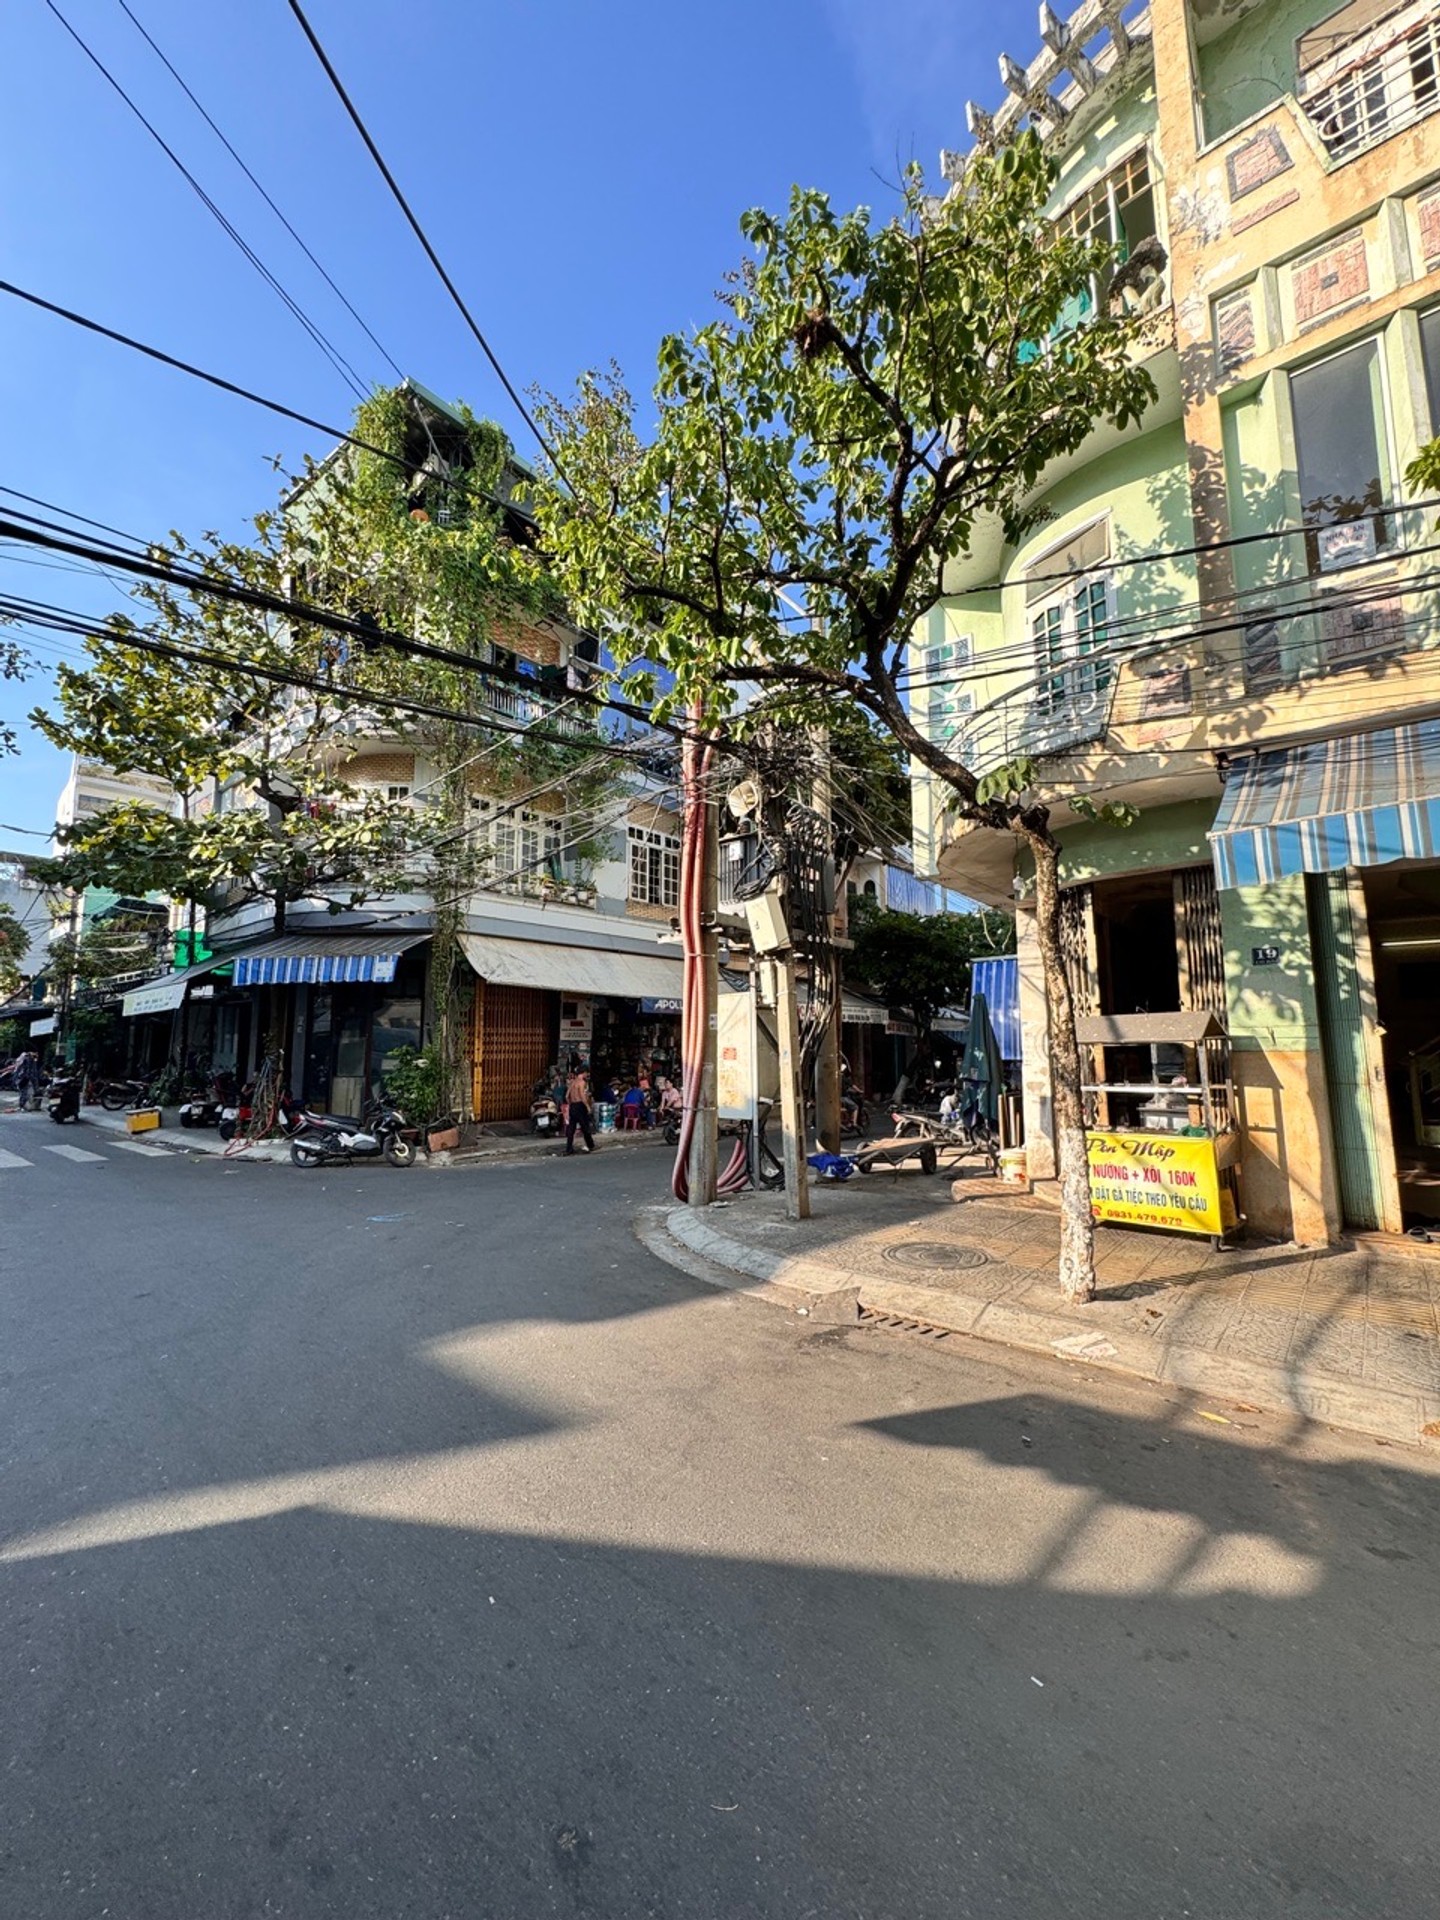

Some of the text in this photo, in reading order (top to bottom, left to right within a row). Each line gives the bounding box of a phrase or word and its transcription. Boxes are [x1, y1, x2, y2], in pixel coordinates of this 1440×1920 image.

[1256, 949, 1277, 959] 19
[1121, 1140, 1175, 1161] Mập
[1143, 1165, 1161, 1183] XÔI
[1168, 1170, 1196, 1187] 160K
[1145, 1192, 1167, 1207] THEO
[1169, 1192, 1186, 1209] YÊU
